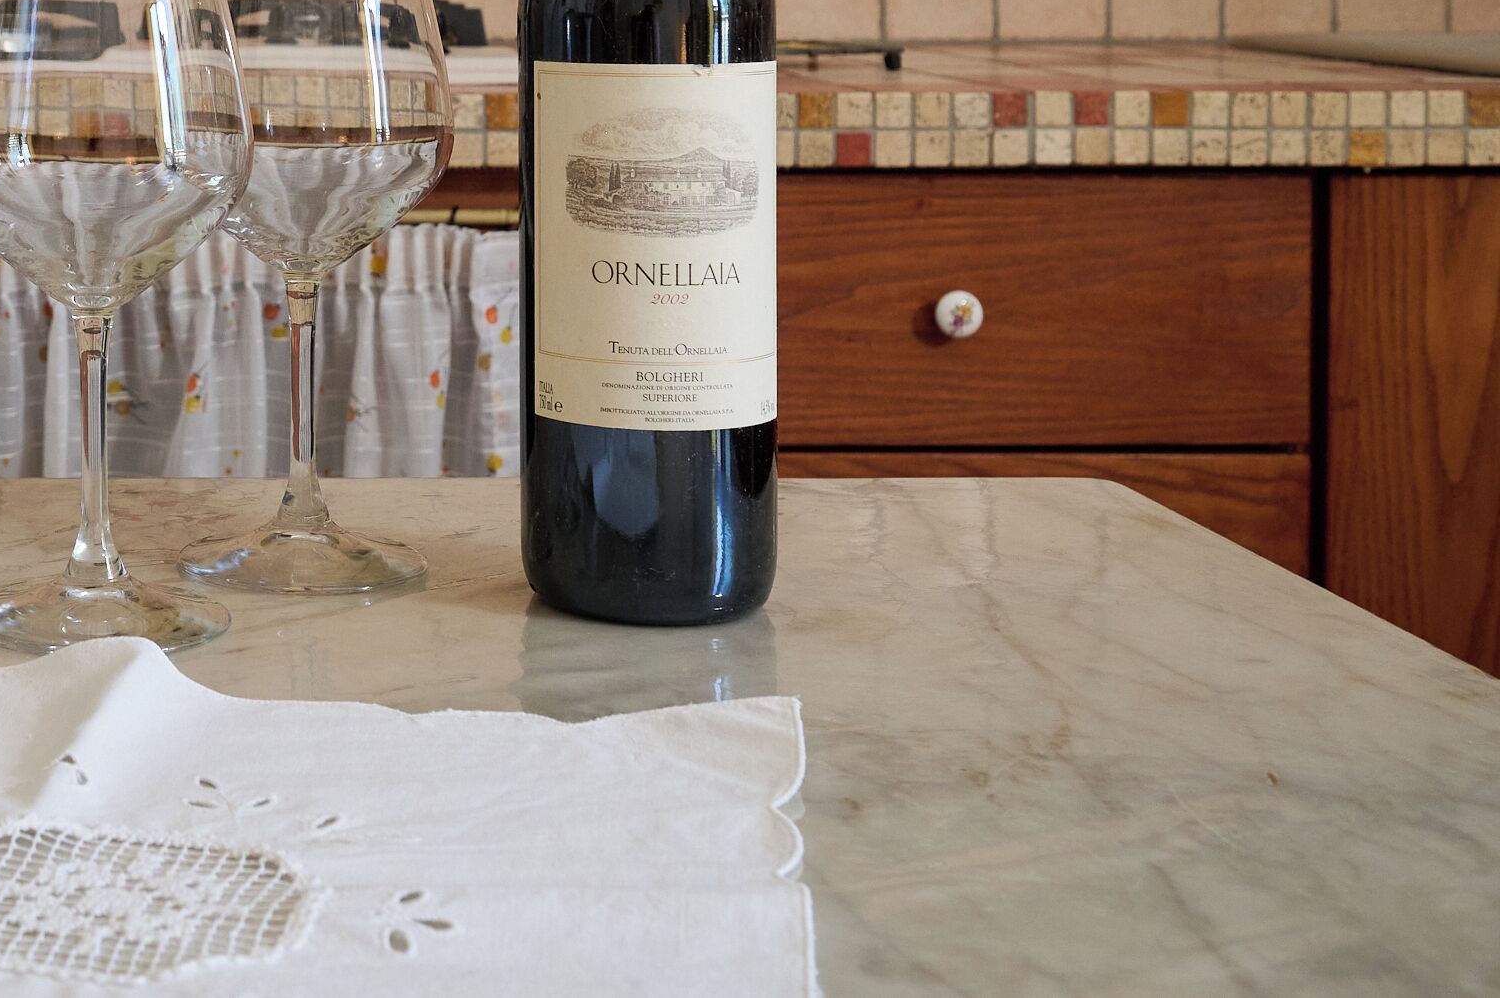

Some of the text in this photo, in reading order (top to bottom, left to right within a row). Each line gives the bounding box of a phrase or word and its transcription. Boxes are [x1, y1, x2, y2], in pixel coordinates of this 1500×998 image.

[591, 259, 740, 287] ORNELLAIA
[651, 293, 689, 305] 2002
[608, 340, 649, 355] TENUTA
[636, 371, 704, 382] BOLGHERI
[601, 382, 654, 391] DENOMINAZIONE
[693, 383, 733, 391] CONTROLLATA
[642, 393, 698, 403] SUPERIORE
